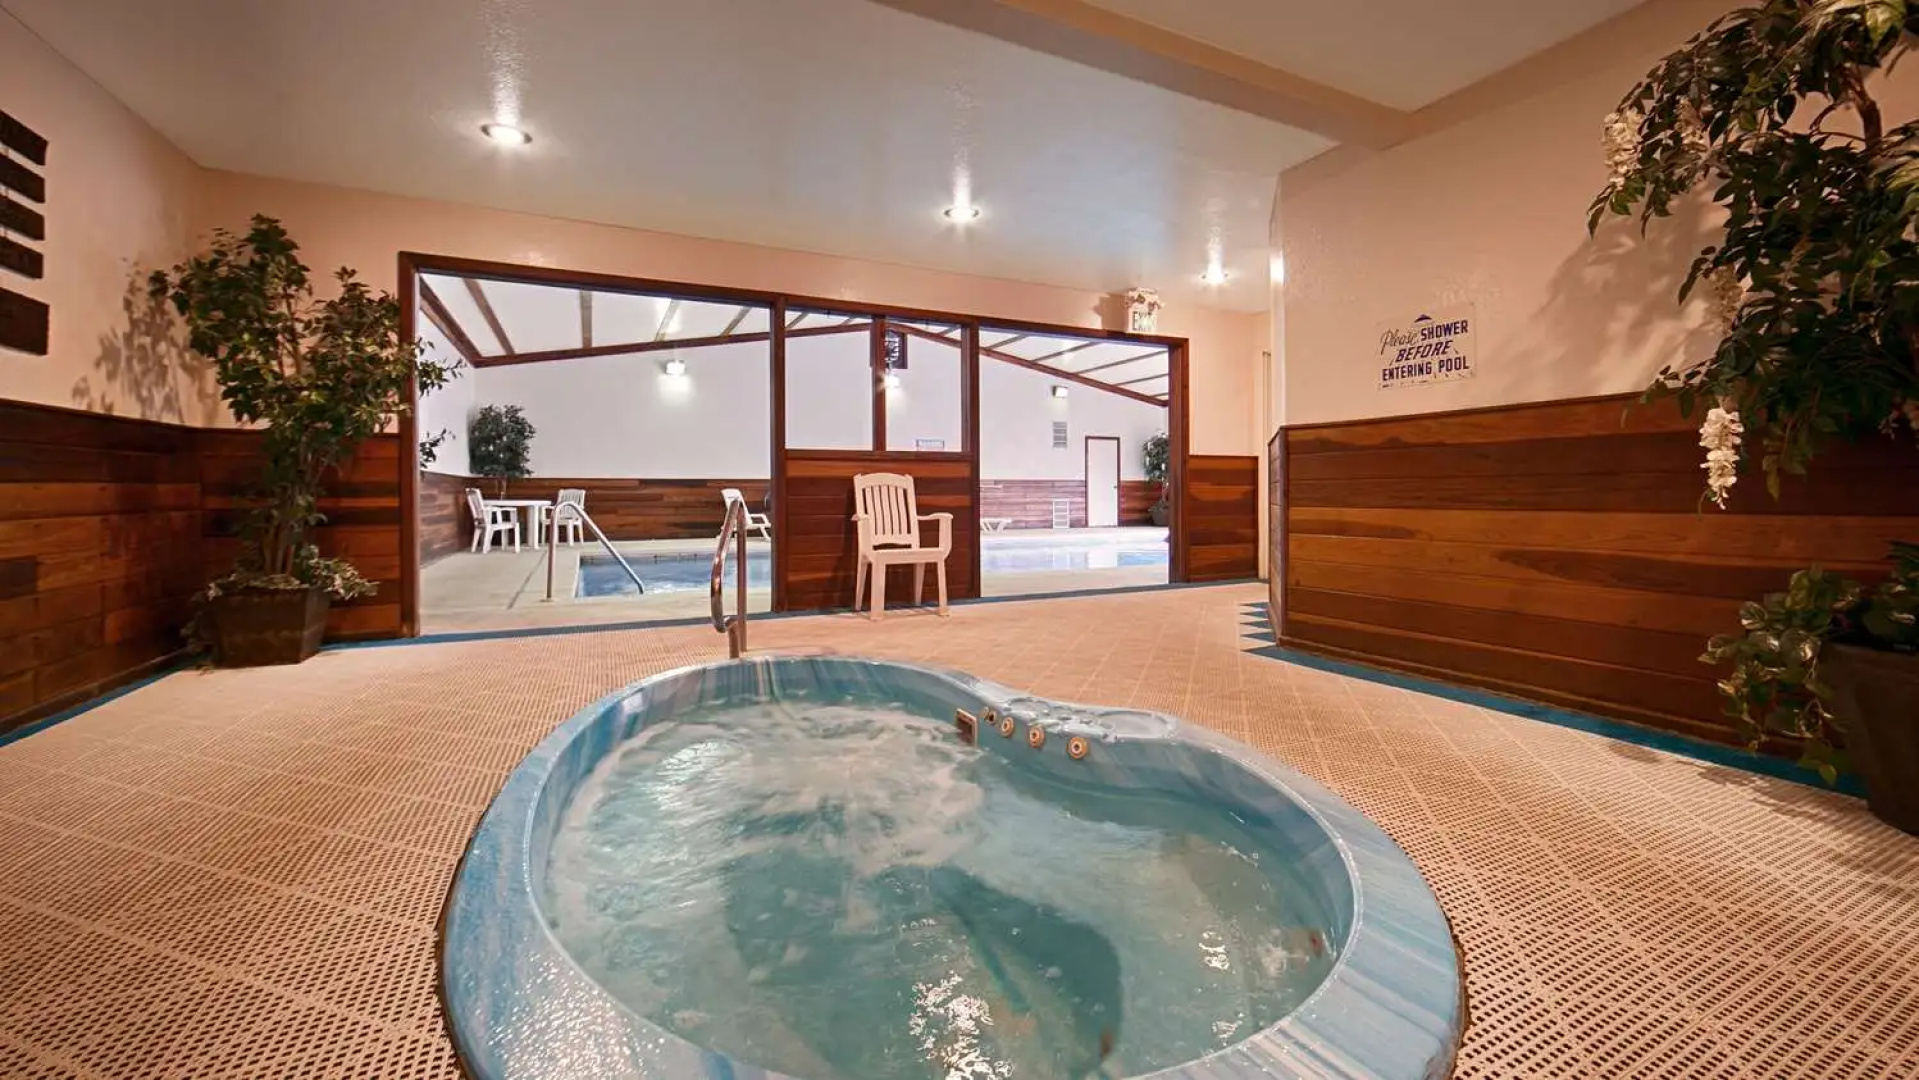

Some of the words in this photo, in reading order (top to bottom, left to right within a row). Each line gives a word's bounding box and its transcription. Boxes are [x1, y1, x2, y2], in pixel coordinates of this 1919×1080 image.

[1381, 327, 1418, 355] Please
[1421, 319, 1469, 341] SHOWER
[1396, 340, 1454, 363] BEFORE
[1382, 361, 1432, 381] ENTERING
[1438, 356, 1469, 373] POOL
